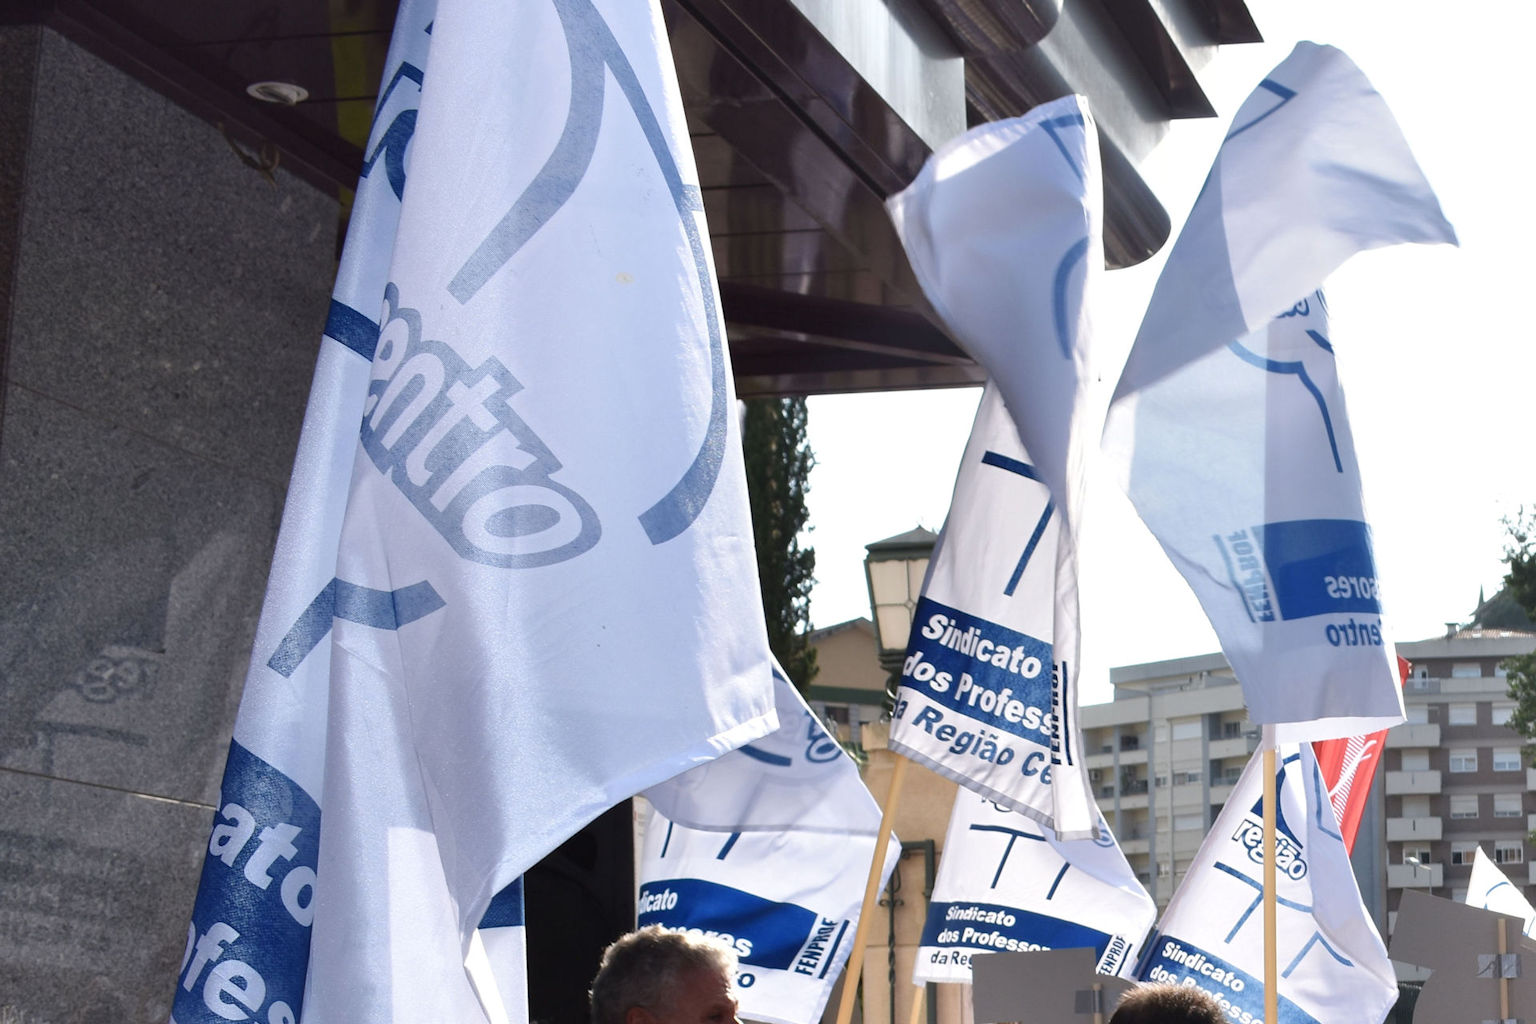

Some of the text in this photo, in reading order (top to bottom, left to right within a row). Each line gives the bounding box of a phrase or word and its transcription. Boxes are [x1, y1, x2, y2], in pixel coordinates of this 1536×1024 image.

[360, 281, 602, 569] entro
[903, 651, 954, 692] dos
[921, 613, 1042, 679] Sindicato
[912, 705, 1015, 766] Região
[937, 928, 960, 944] dos
[945, 906, 1016, 927] Sindicato
[795, 917, 840, 977] FENPROF
[930, 951, 949, 965] da
[1162, 941, 1245, 993] Sindicato
